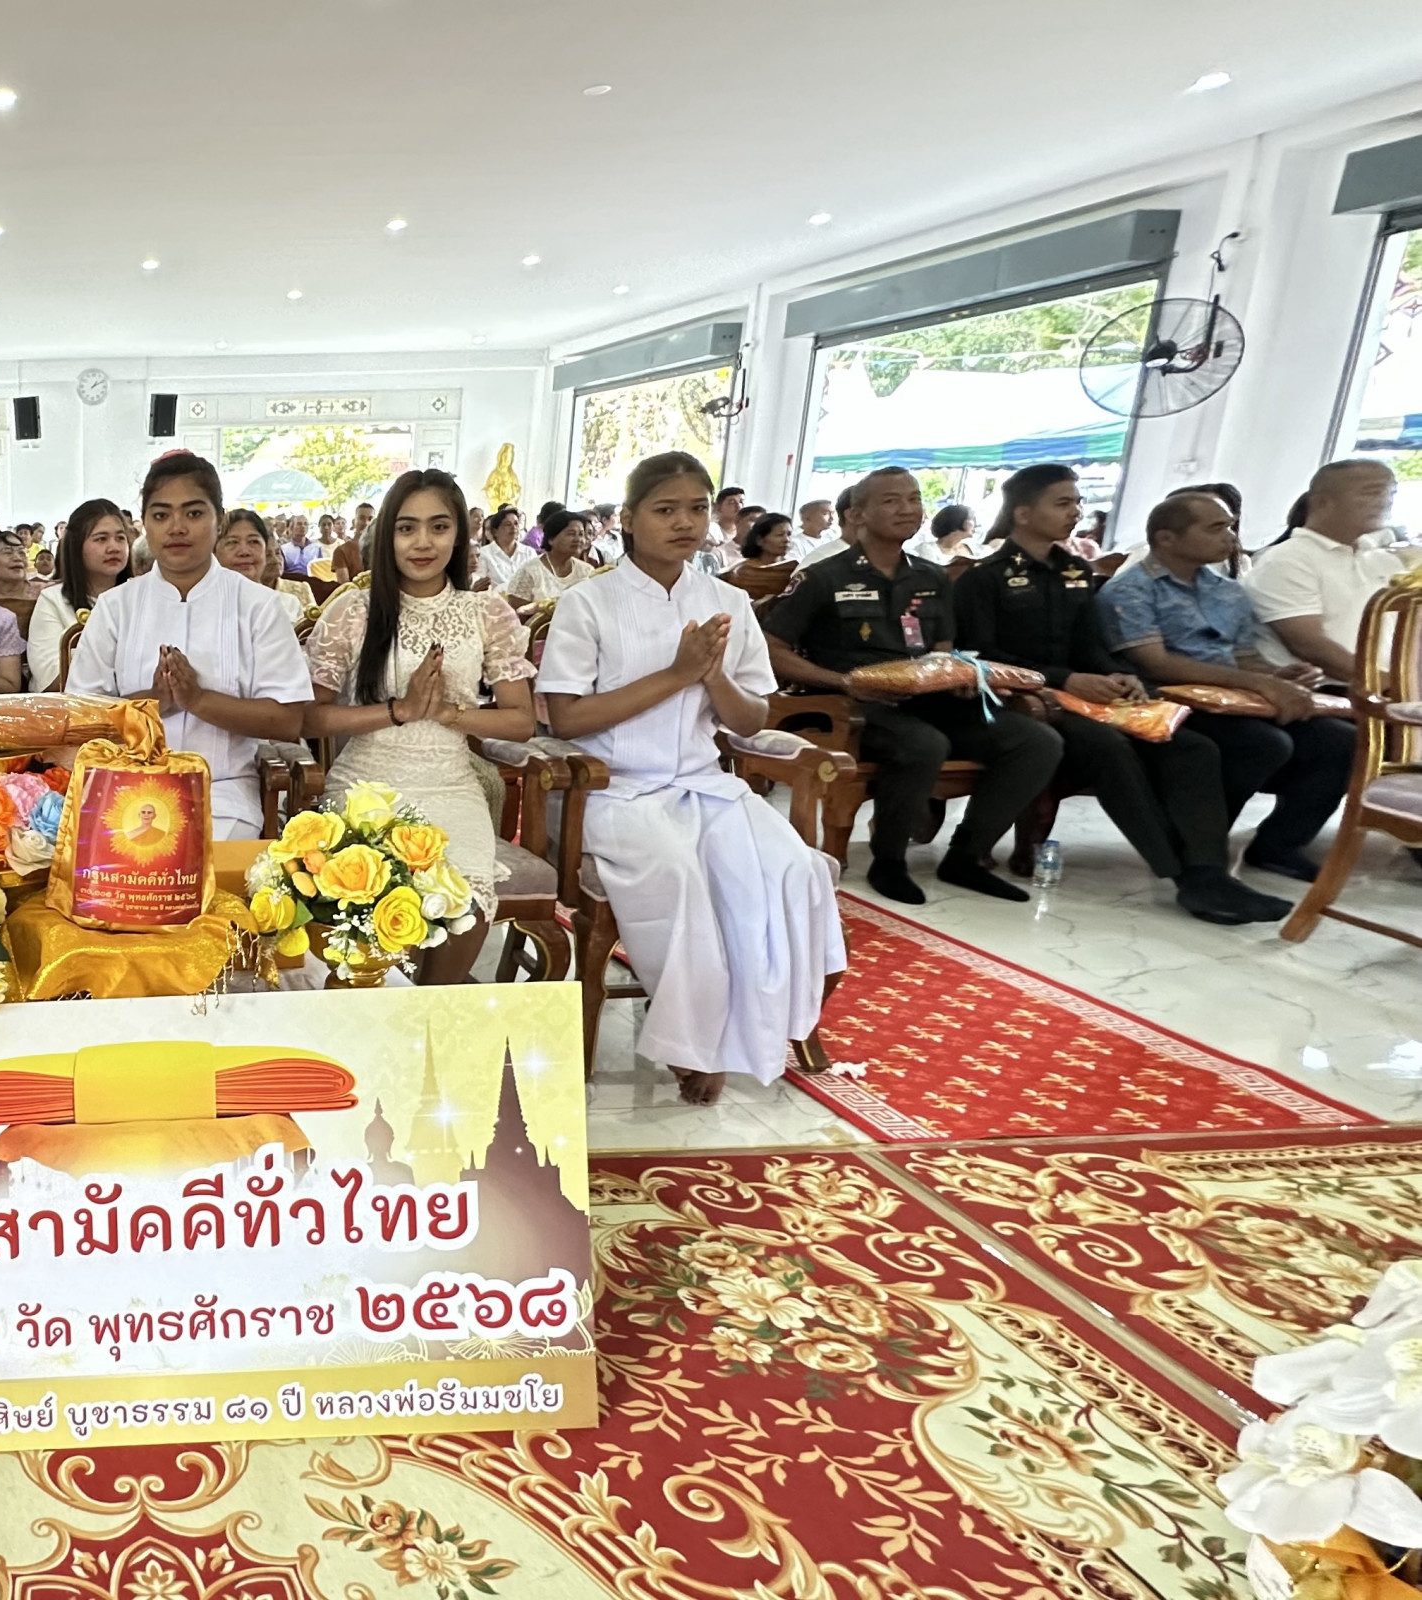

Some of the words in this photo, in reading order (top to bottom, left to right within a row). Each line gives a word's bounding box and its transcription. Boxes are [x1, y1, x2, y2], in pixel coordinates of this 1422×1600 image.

[15, 1303, 73, 1348] วัด
[88, 1294, 335, 1362] พุทธศักราช
[355, 1279, 569, 1334] ๒๕๖๘
[67, 1399, 212, 1437] บูชาธรรม
[226, 1397, 268, 1421] ๘๑
[281, 1388, 302, 1417] ปี
[315, 1379, 561, 1416] หลวงพ่อธัมมชโย
